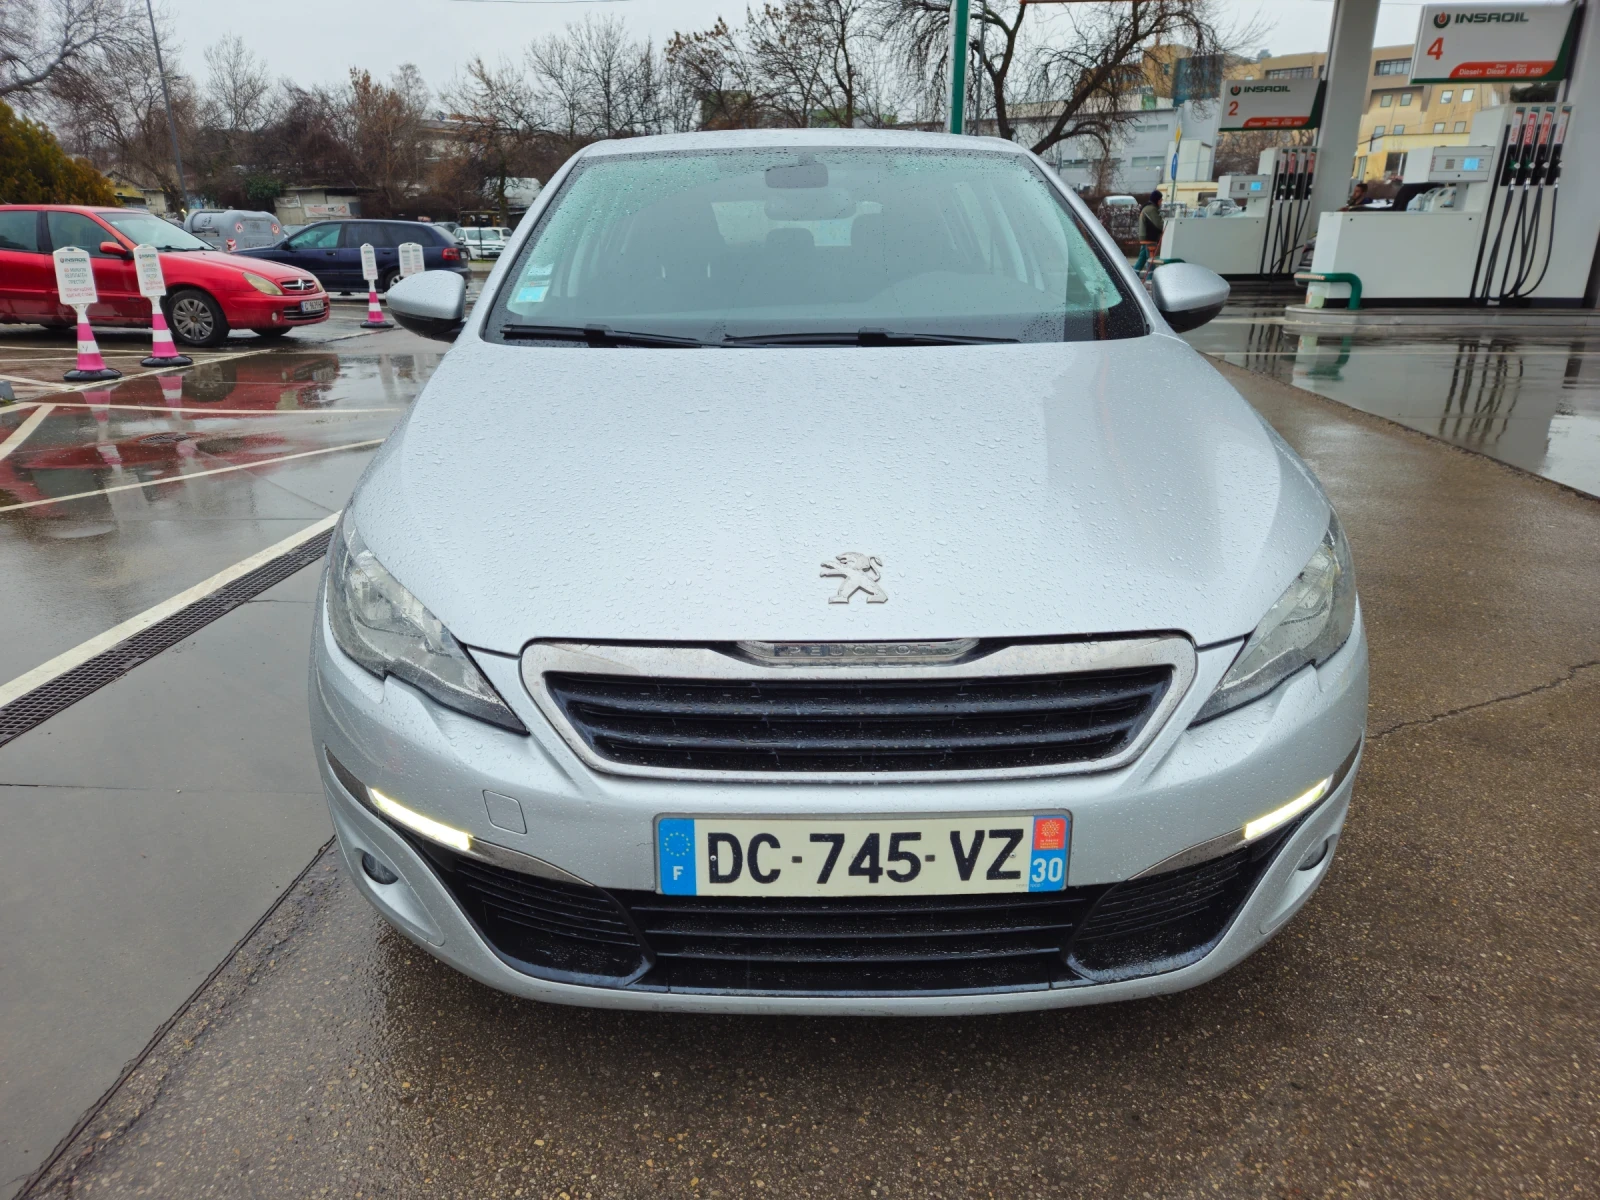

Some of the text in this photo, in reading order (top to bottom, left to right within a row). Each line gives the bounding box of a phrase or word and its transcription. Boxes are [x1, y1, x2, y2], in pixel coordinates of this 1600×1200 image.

[1455, 13, 1529, 23] INSAOIL
[1427, 37, 1444, 60] 4
[1486, 67, 1507, 75] Diesel
[1228, 100, 1239, 116] 2
[1525, 126, 1533, 143] A100
[672, 865, 683, 880] F
[1031, 857, 1063, 883] 30
